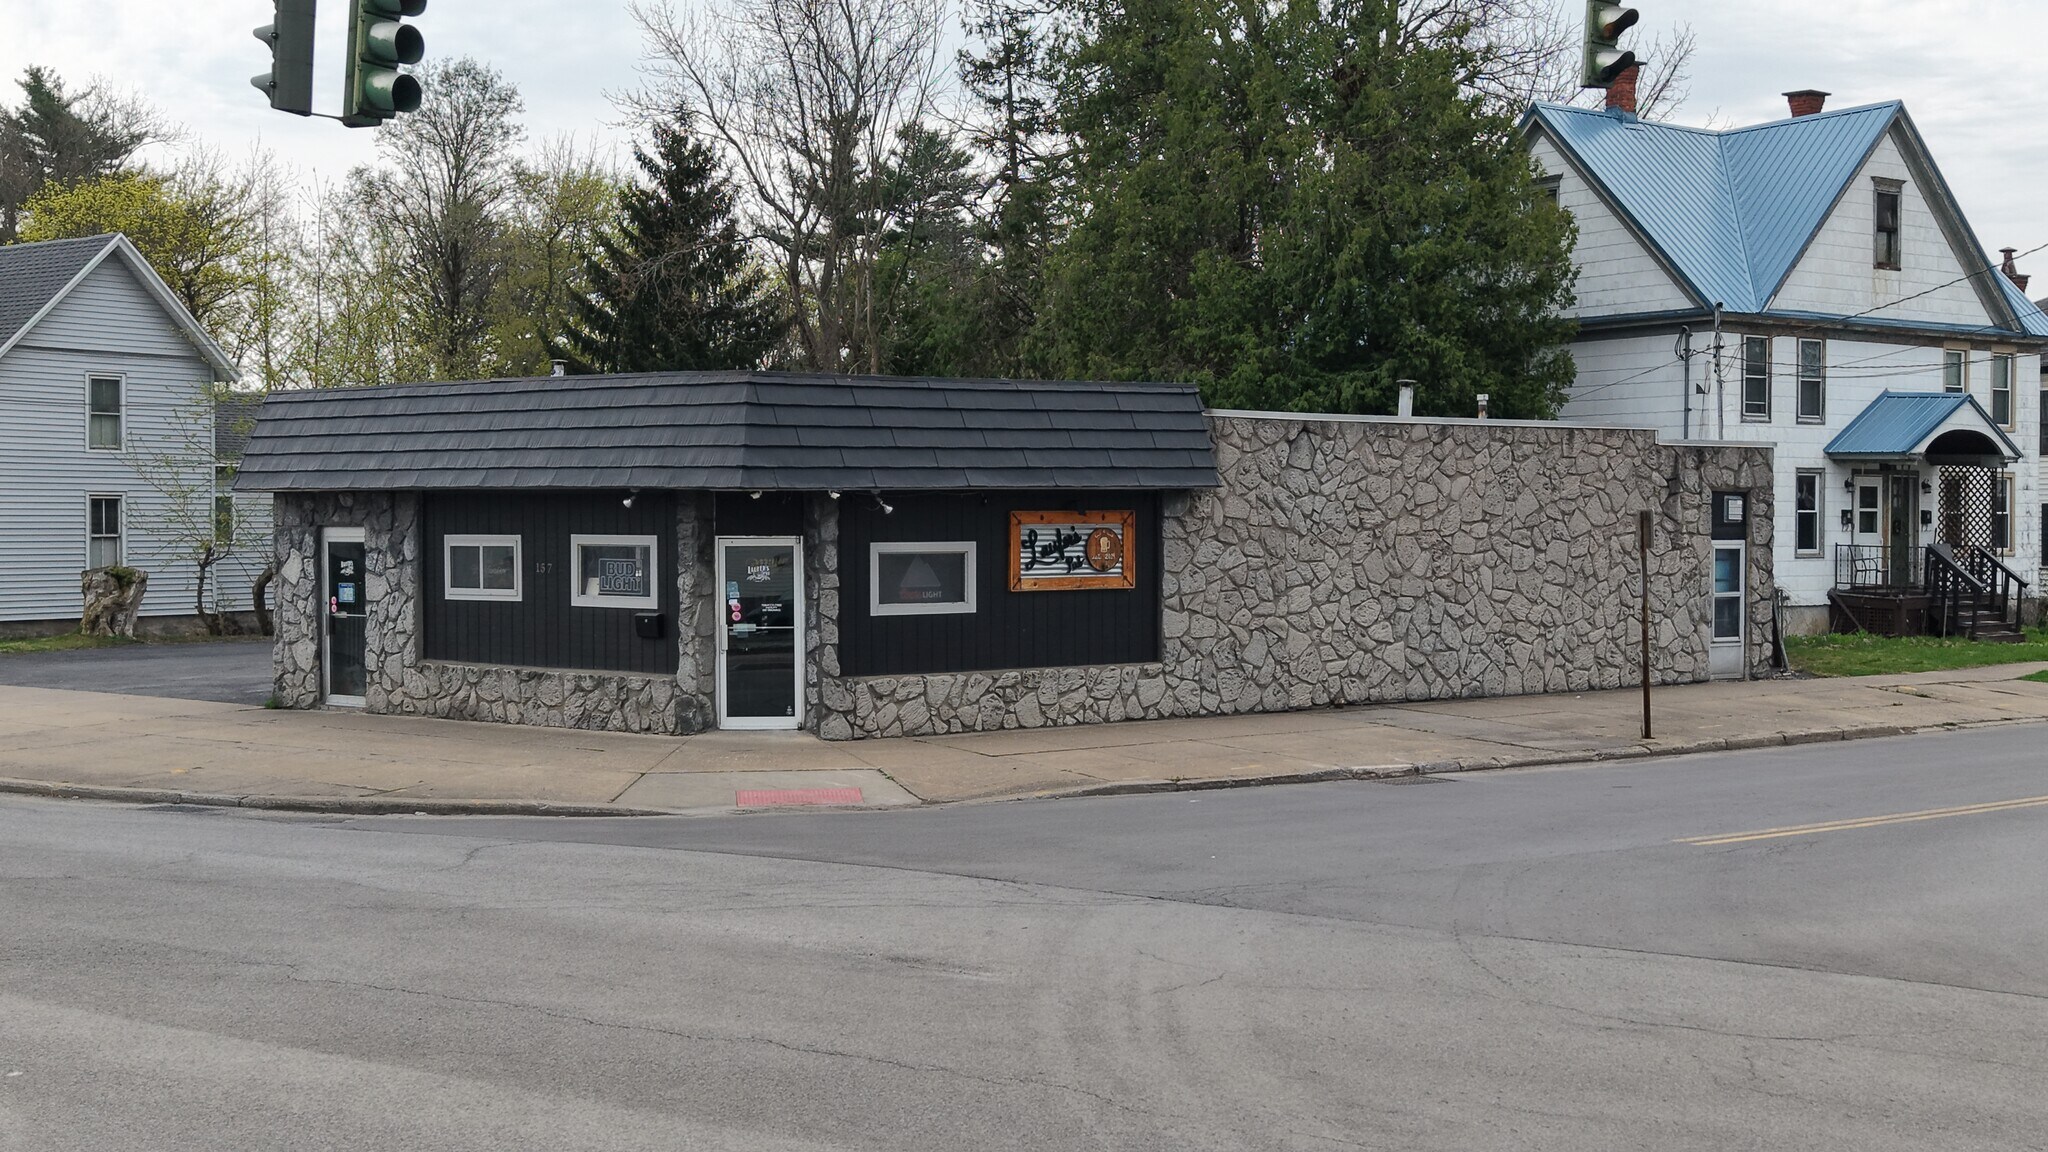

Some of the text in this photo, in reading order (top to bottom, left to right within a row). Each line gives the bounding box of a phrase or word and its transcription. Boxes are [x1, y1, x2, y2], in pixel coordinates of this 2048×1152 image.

[535, 562, 552, 574] 157
[606, 562, 635, 576] BUD
[600, 576, 641, 591] LIGHT
